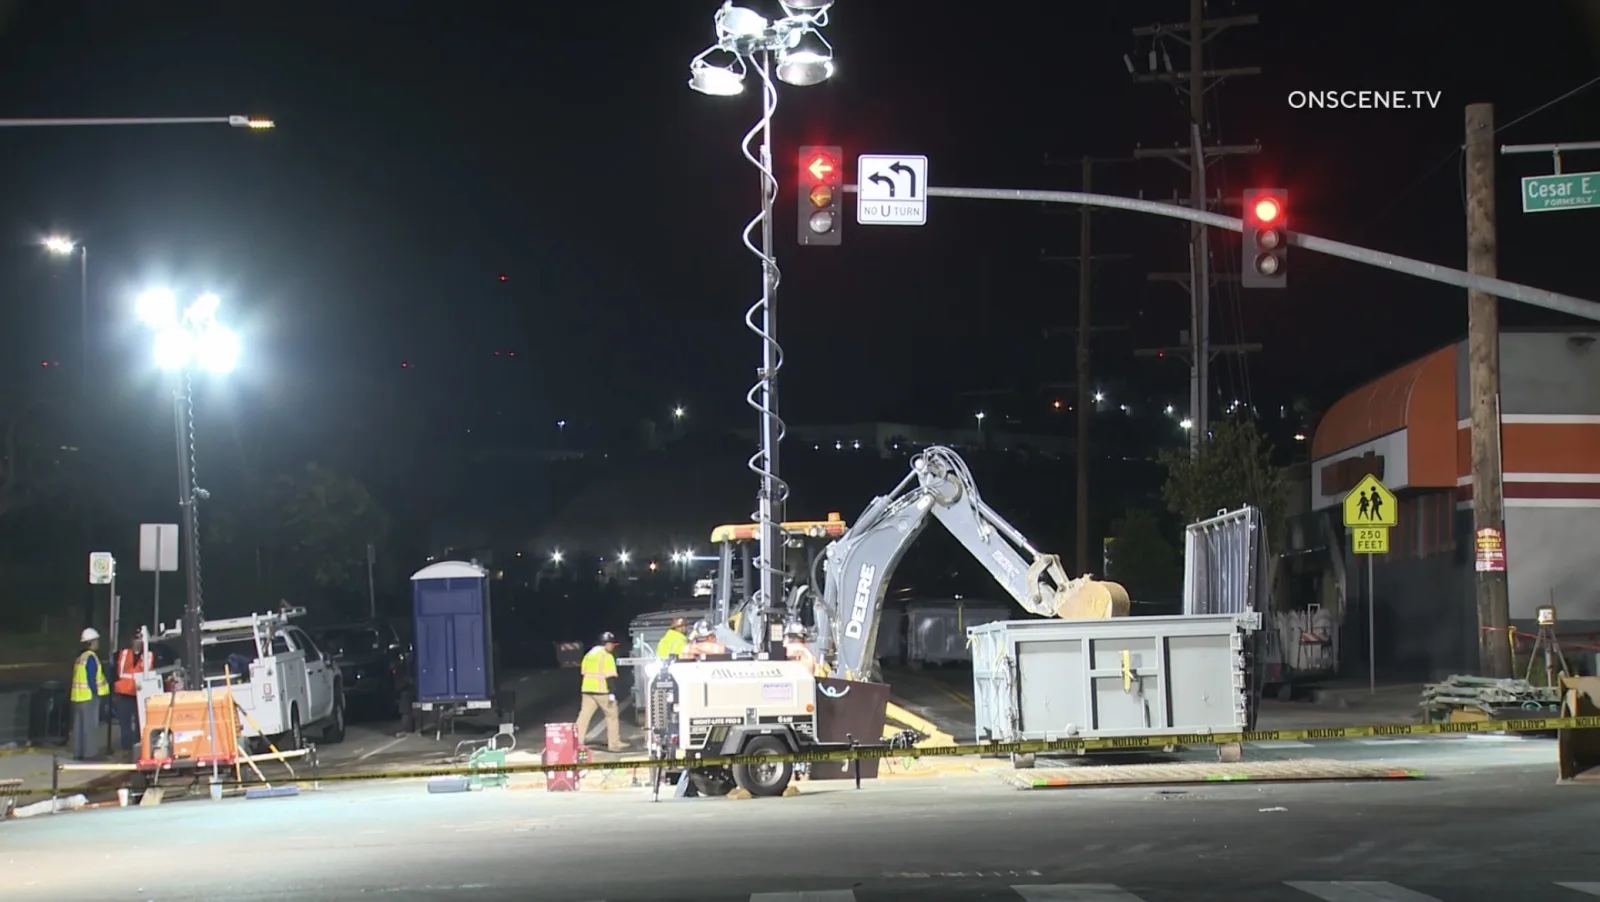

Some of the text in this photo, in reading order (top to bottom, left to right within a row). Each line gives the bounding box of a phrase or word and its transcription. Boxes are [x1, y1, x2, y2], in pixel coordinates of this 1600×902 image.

[1528, 176, 1597, 198] Cesar E.
[1544, 196, 1593, 207] FORMERLY
[864, 205, 920, 218] NO U TURN
[1360, 530, 1381, 539] 250
[1358, 540, 1383, 549] FEET
[845, 563, 876, 640] DEERE
[1373, 725, 1411, 735] CAUTION
[1439, 722, 1478, 733] CAUTION
[1507, 719, 1546, 730] CAUTION
[1177, 733, 1214, 744] CAUTION
[1241, 731, 1280, 741] CAUTION
[1307, 728, 1345, 738] CAUTION
[1047, 739, 1085, 750] CAUTION
[1112, 736, 1149, 747] CAUTION
[920, 746, 957, 756] CAUTION
[984, 743, 1021, 753] CAUTION
[857, 749, 893, 759] CAUTION
